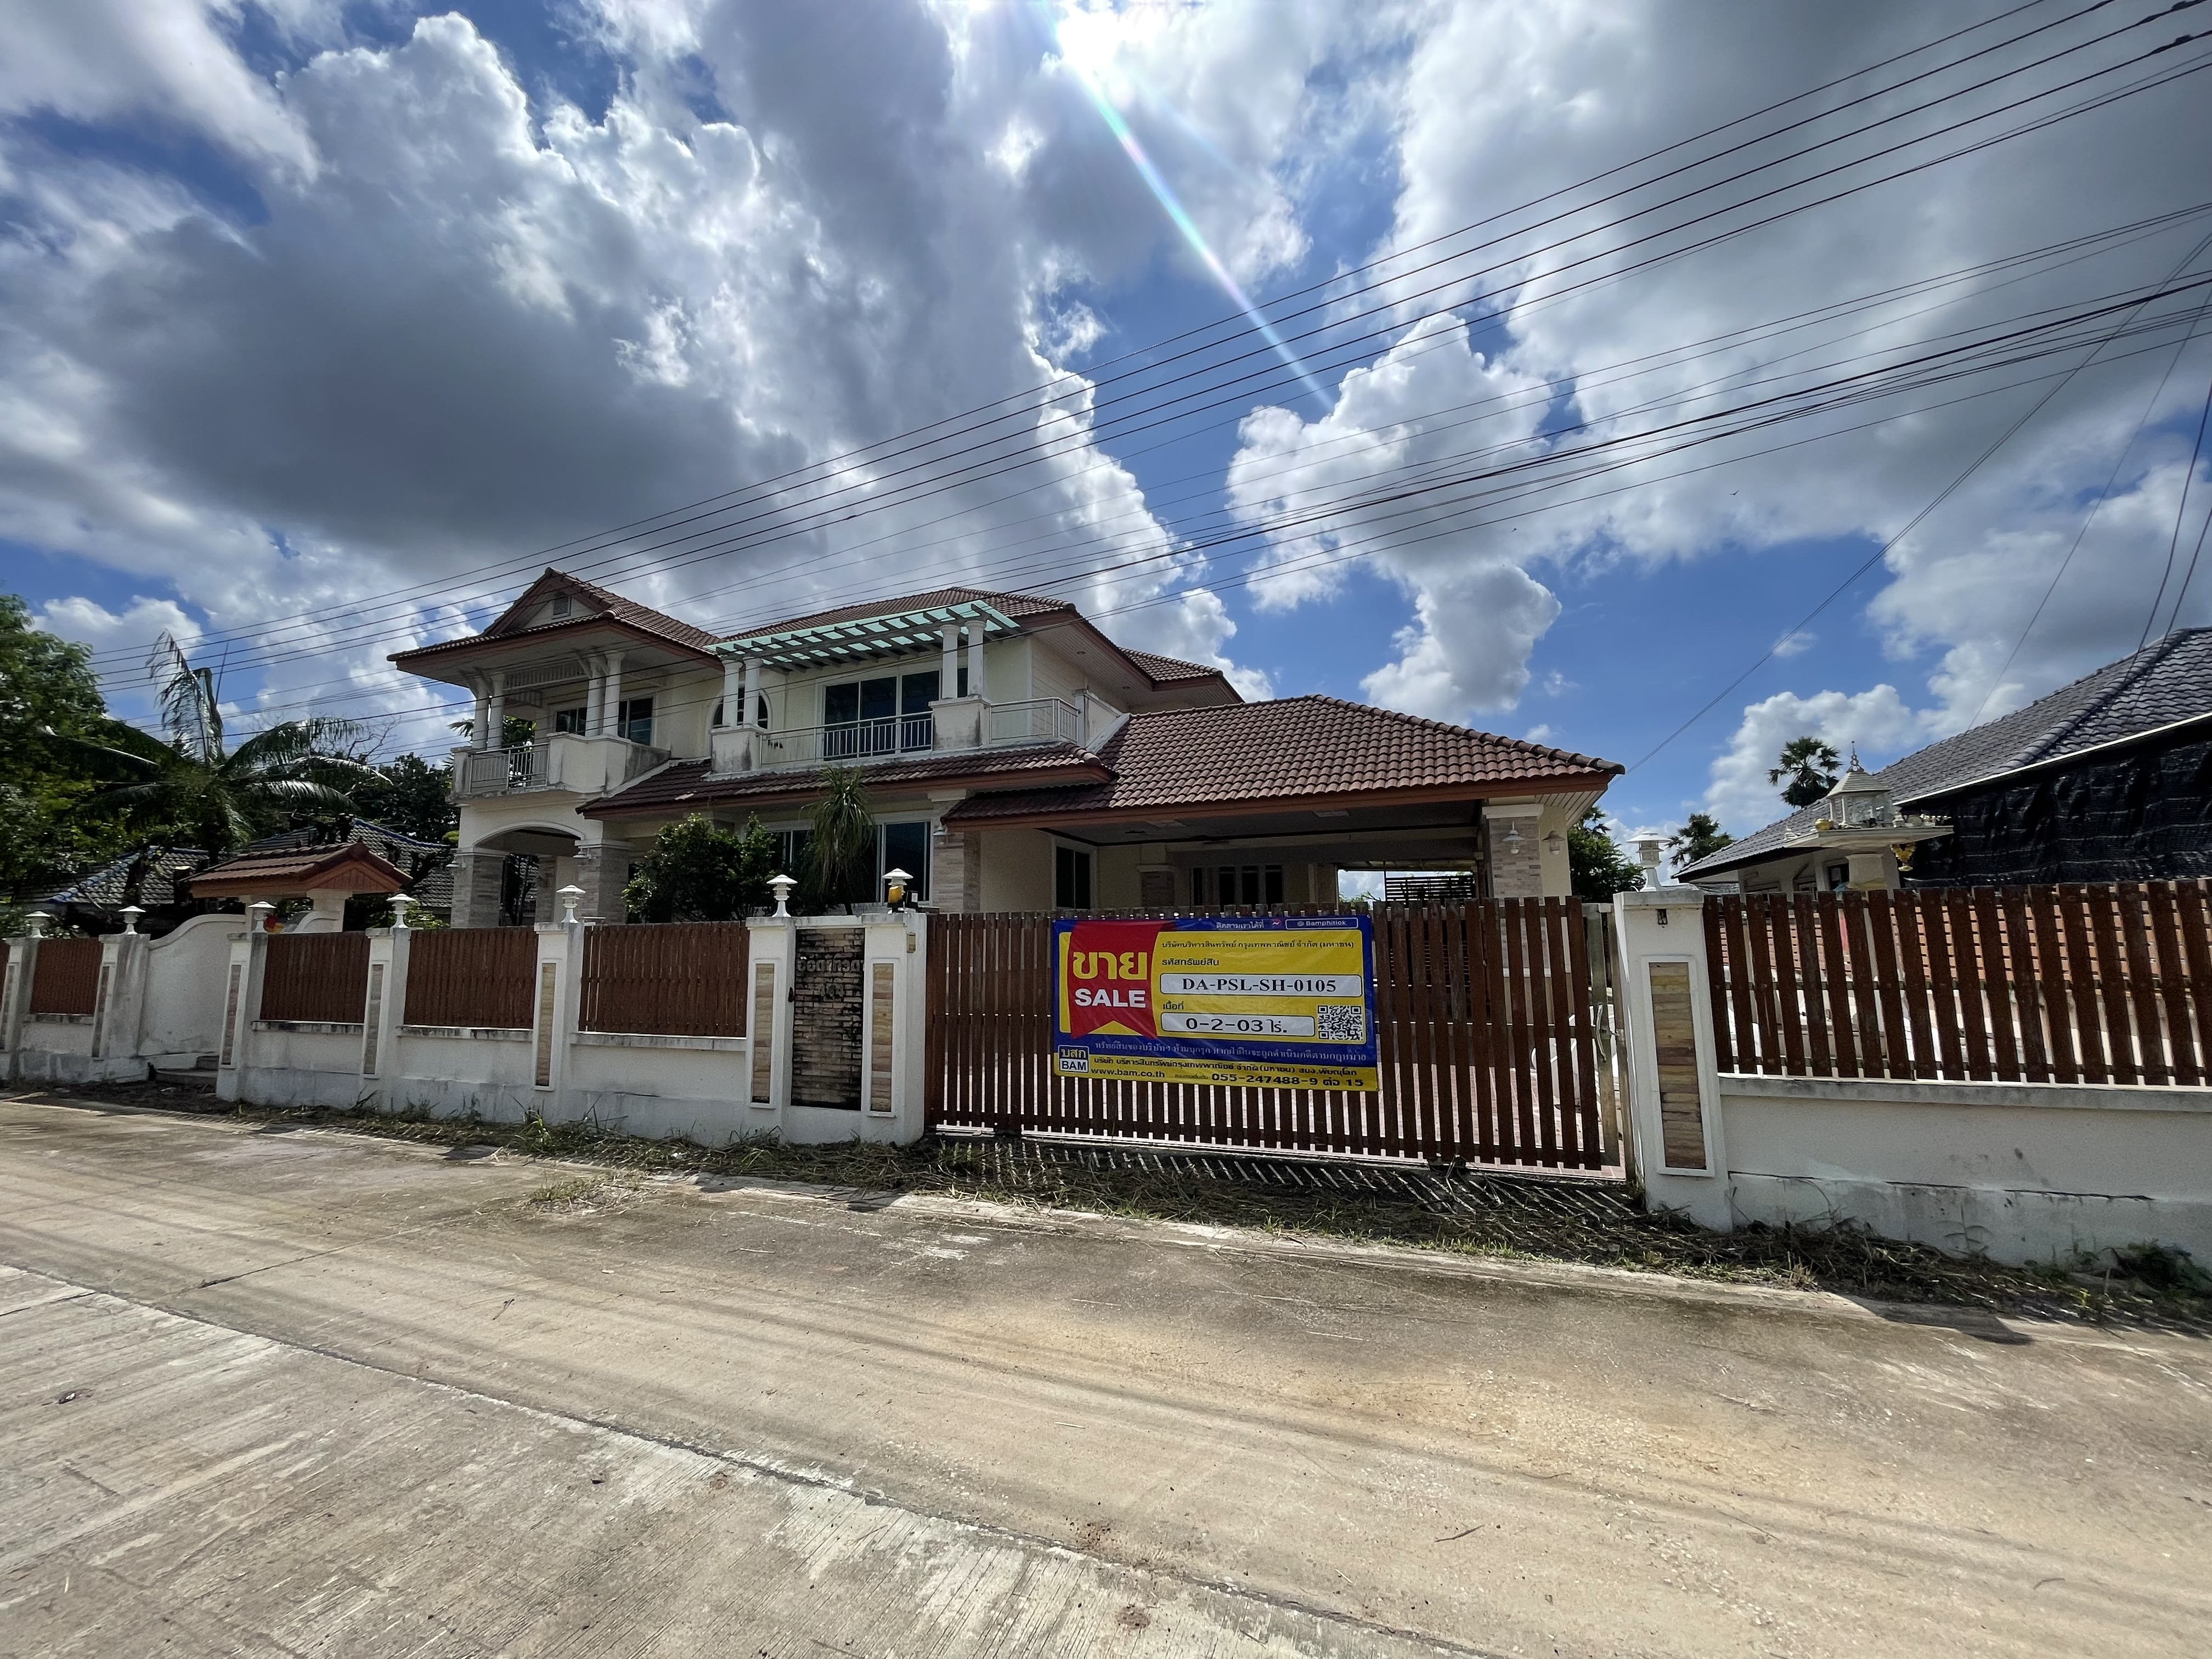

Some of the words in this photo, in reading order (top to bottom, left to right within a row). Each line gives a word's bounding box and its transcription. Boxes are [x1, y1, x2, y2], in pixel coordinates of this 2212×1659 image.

[1073, 952, 1147, 980] ขาย
[1182, 978, 1336, 992] DA-PSL-SH-0105
[1075, 988, 1146, 1008] SALE
[1163, 1001, 1184, 1010] เนื้อที่
[1186, 1018, 1262, 1032] 0-2-03
[1061, 1048, 1086, 1058] บสก
[1062, 1061, 1086, 1070] BAM
[1091, 1069, 1165, 1078] www.bam.co.th
[1211, 1074, 1318, 1085] 055-247488-9
[1323, 1076, 1340, 1086] ต่อ
